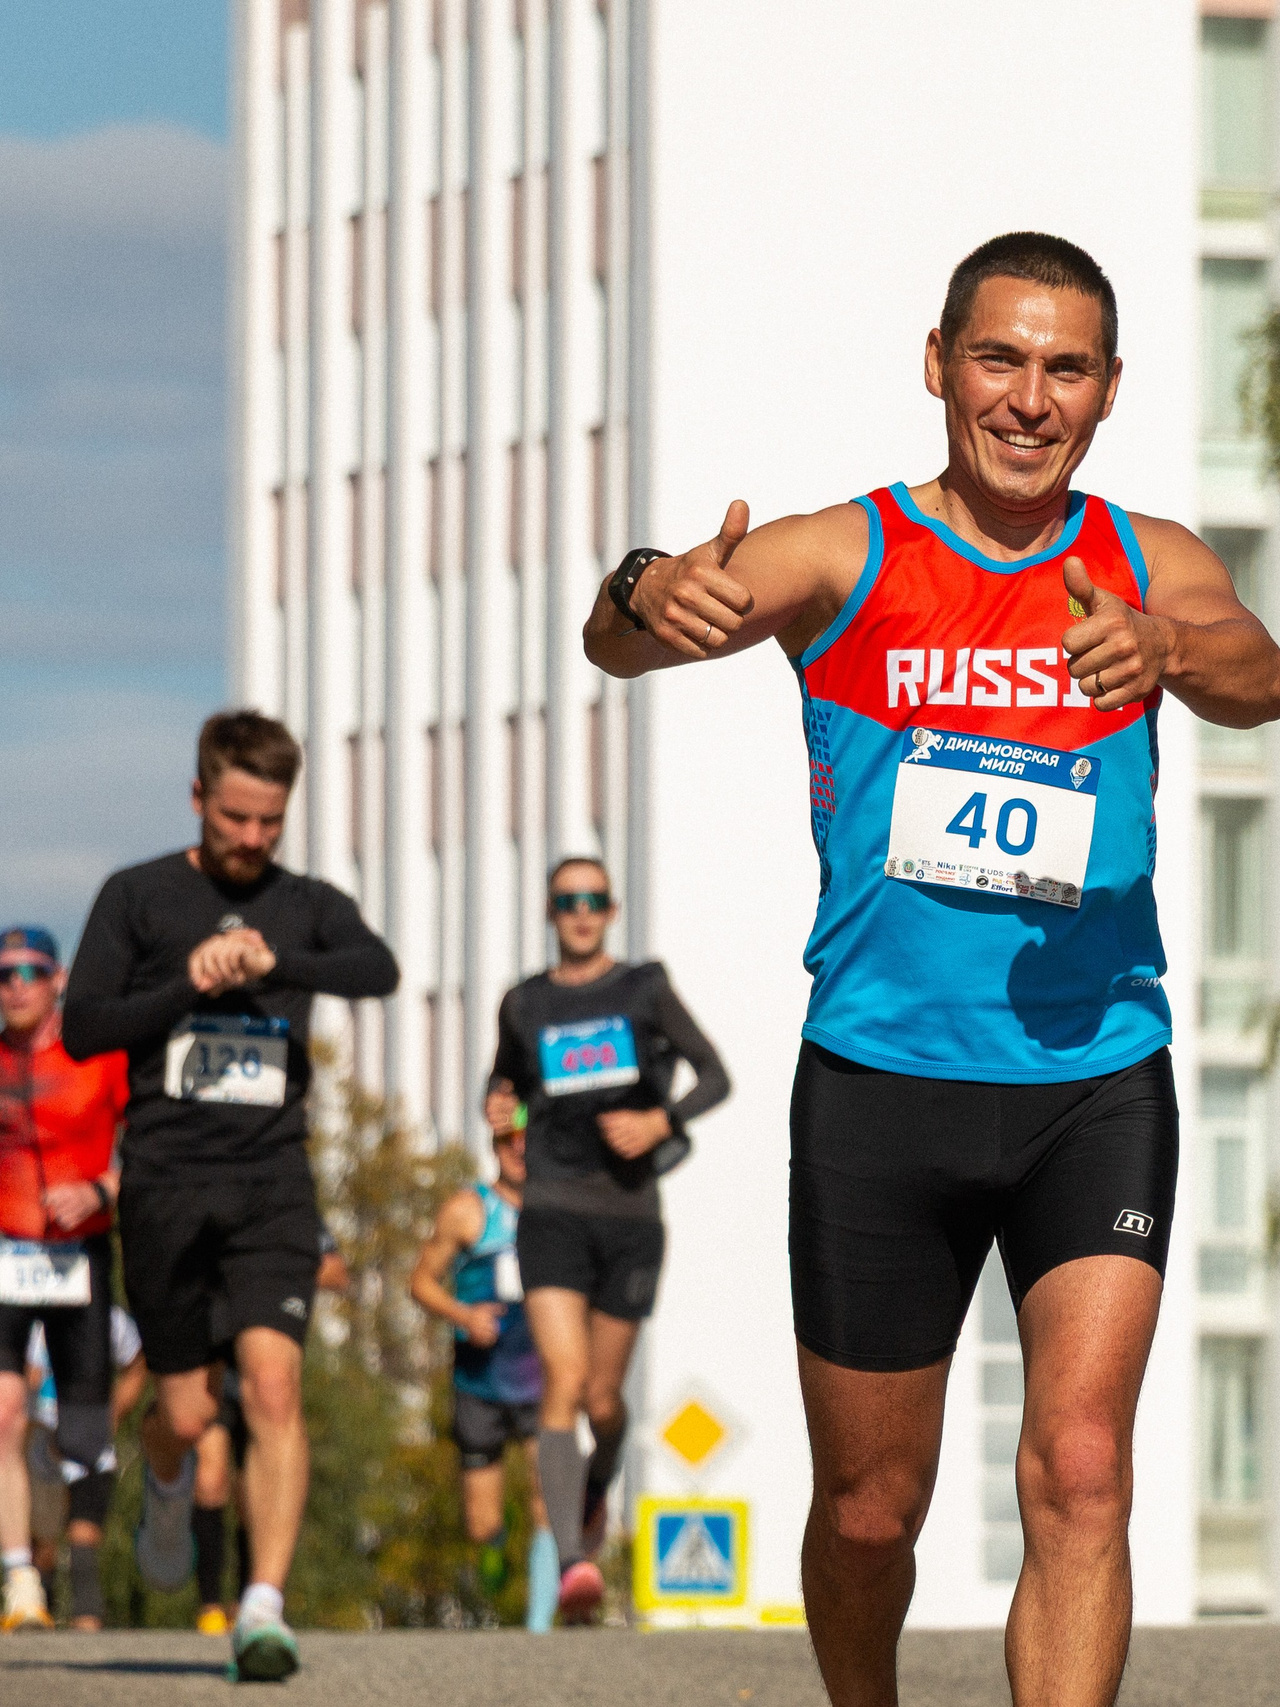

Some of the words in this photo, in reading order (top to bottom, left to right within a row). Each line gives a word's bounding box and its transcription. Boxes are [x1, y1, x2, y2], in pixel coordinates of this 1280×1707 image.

[886, 647, 1123, 711] RUSSI
[943, 736, 1060, 768] ДИНАМОВСКАЯ
[978, 756, 1026, 776] МИЛЯ
[944, 791, 1038, 856] 40
[936, 861, 956, 870] Nika
[987, 868, 1004, 877] UDS
[990, 883, 1014, 893] Effort
